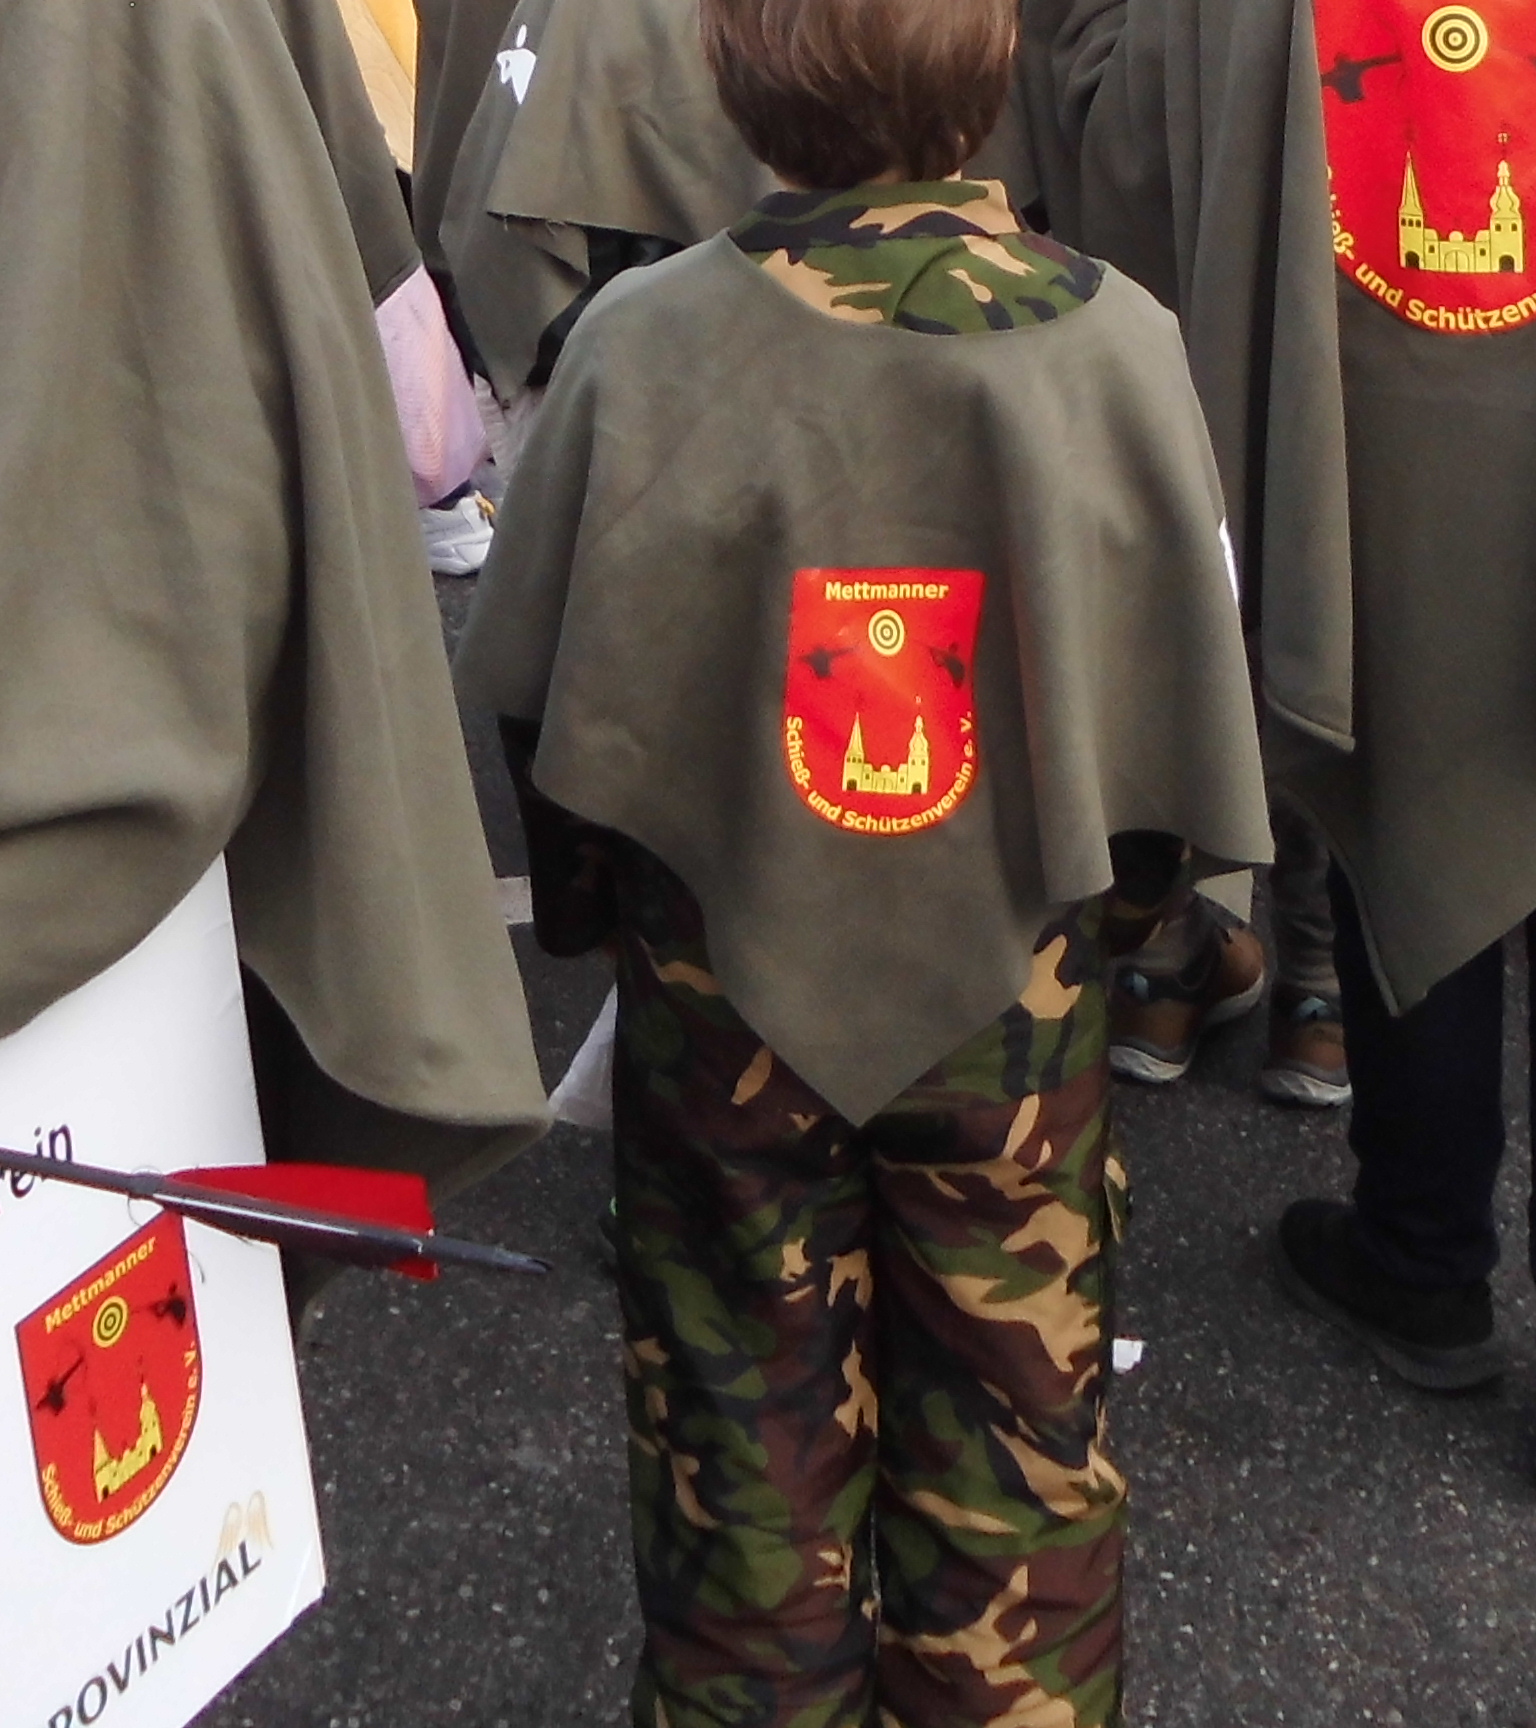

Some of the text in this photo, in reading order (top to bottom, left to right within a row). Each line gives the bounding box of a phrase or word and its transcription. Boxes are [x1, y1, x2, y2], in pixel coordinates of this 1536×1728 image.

[1355, 261, 1405, 308] und
[824, 581, 949, 601] Mettmanner
[786, 715, 811, 790] Schieß-
[807, 790, 843, 821] und
[842, 761, 973, 832] Schützenverein
[45, 1236, 157, 1334] Mettmanner
[42, 1463, 73, 1527] Schieß-
[74, 1517, 102, 1539] und
[105, 1392, 196, 1535] Schützenverein
